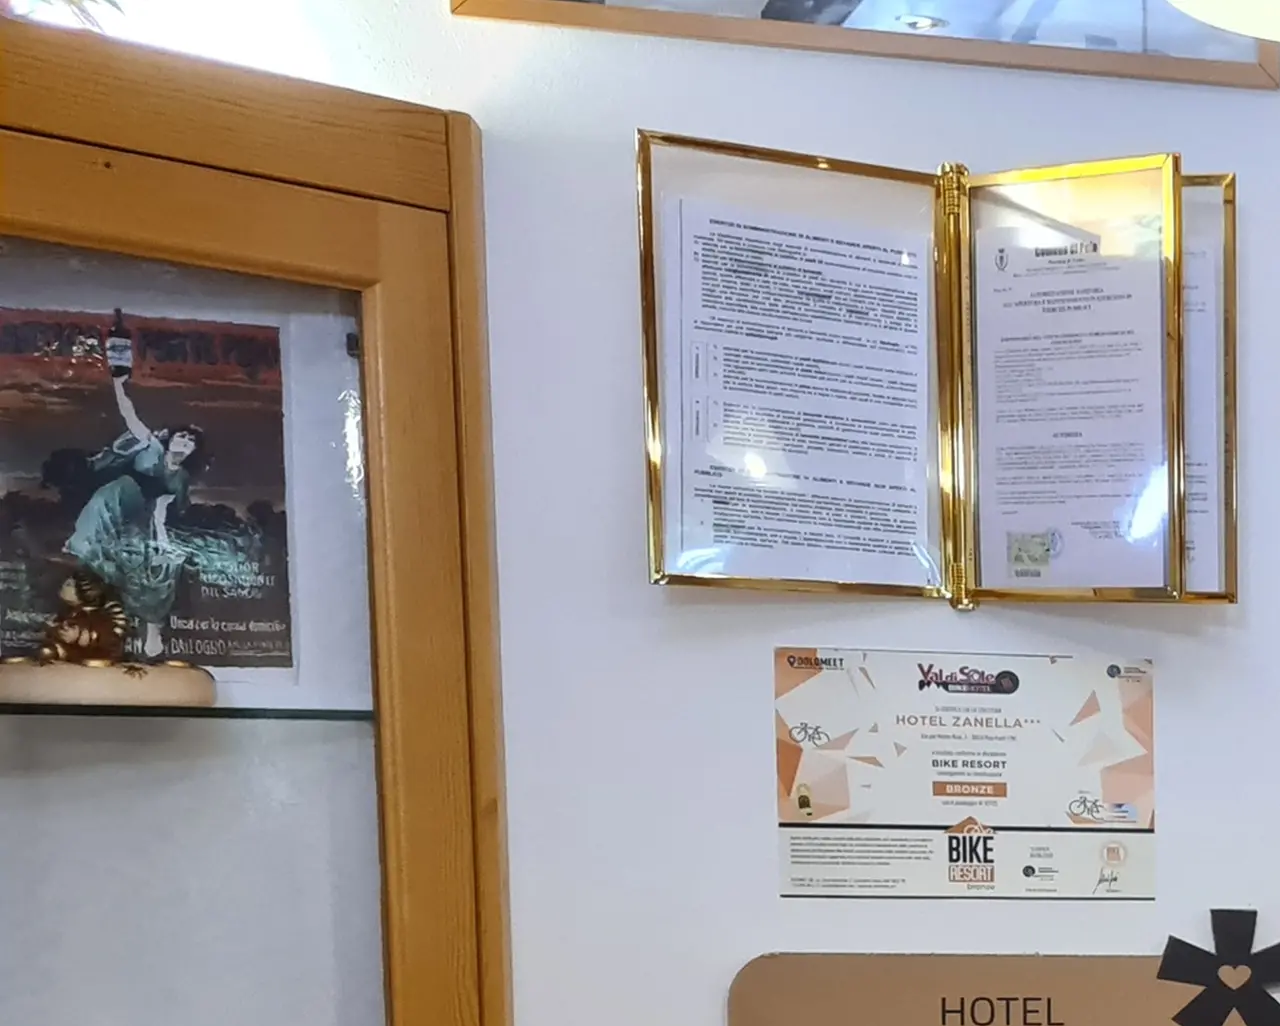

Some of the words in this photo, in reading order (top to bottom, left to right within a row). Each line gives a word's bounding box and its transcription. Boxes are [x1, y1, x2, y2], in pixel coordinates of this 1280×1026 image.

[917, 663, 942, 683] Val
[896, 715, 947, 727] HOTEL
[931, 759, 958, 768] BIKE
[961, 759, 1007, 769] RESORT
[945, 784, 994, 795] BRONZE
[948, 835, 995, 863] BIKE
[949, 865, 995, 882] RESORT
[941, 997, 1064, 1026] HOTEL
